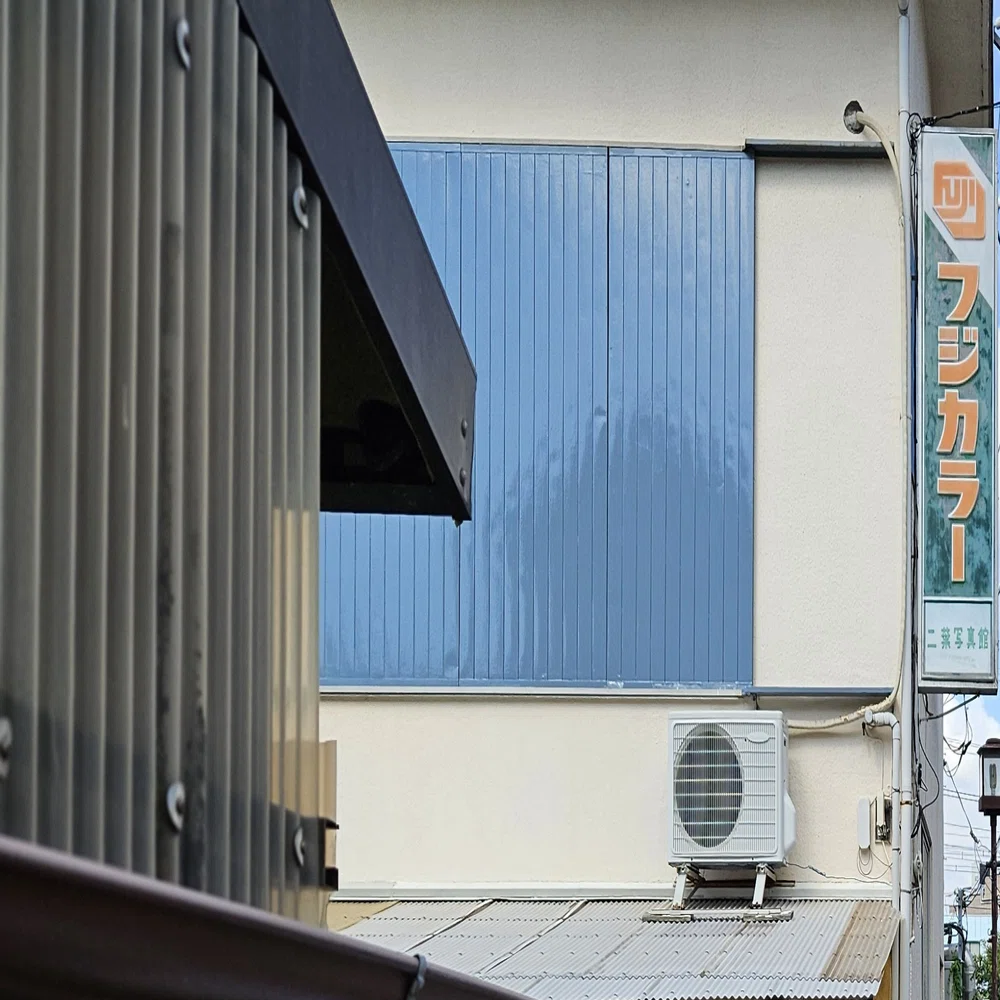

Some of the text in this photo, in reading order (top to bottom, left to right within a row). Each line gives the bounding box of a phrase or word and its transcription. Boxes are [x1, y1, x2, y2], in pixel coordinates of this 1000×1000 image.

[936, 262, 980, 582] フジカラー
[927, 626, 989, 649] 二葉写真館
